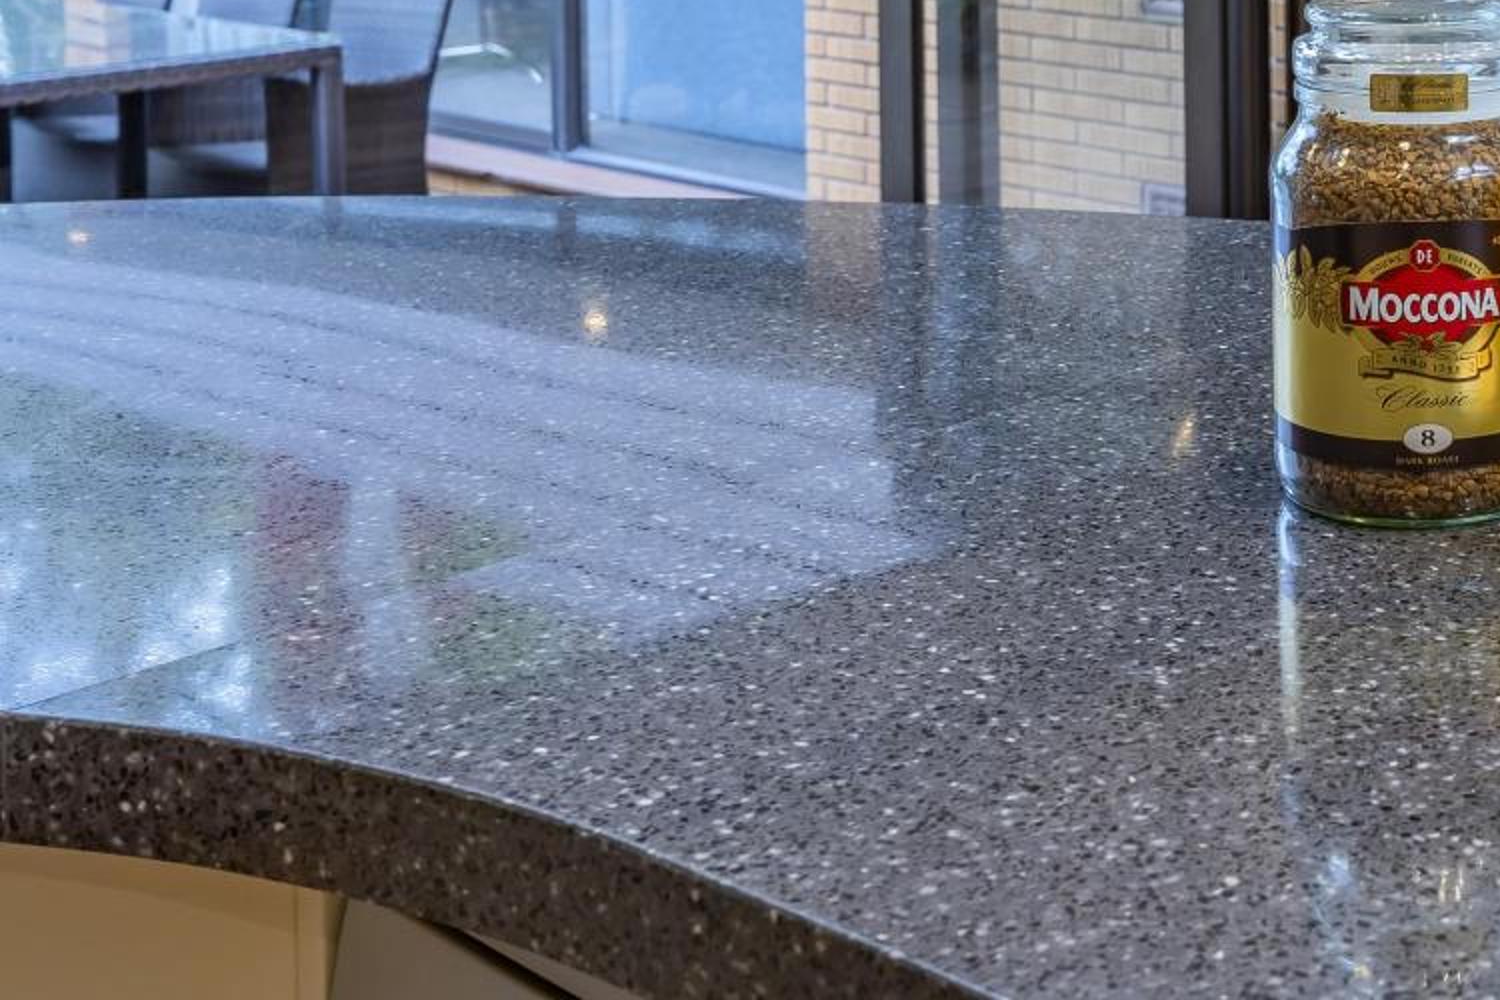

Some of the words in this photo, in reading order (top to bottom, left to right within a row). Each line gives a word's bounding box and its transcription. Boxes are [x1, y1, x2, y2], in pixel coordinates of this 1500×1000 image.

[1416, 249, 1433, 264] DE
[1349, 286, 1500, 324] MOCCONA
[1376, 385, 1470, 413] Classic
[1421, 429, 1435, 447] 8
